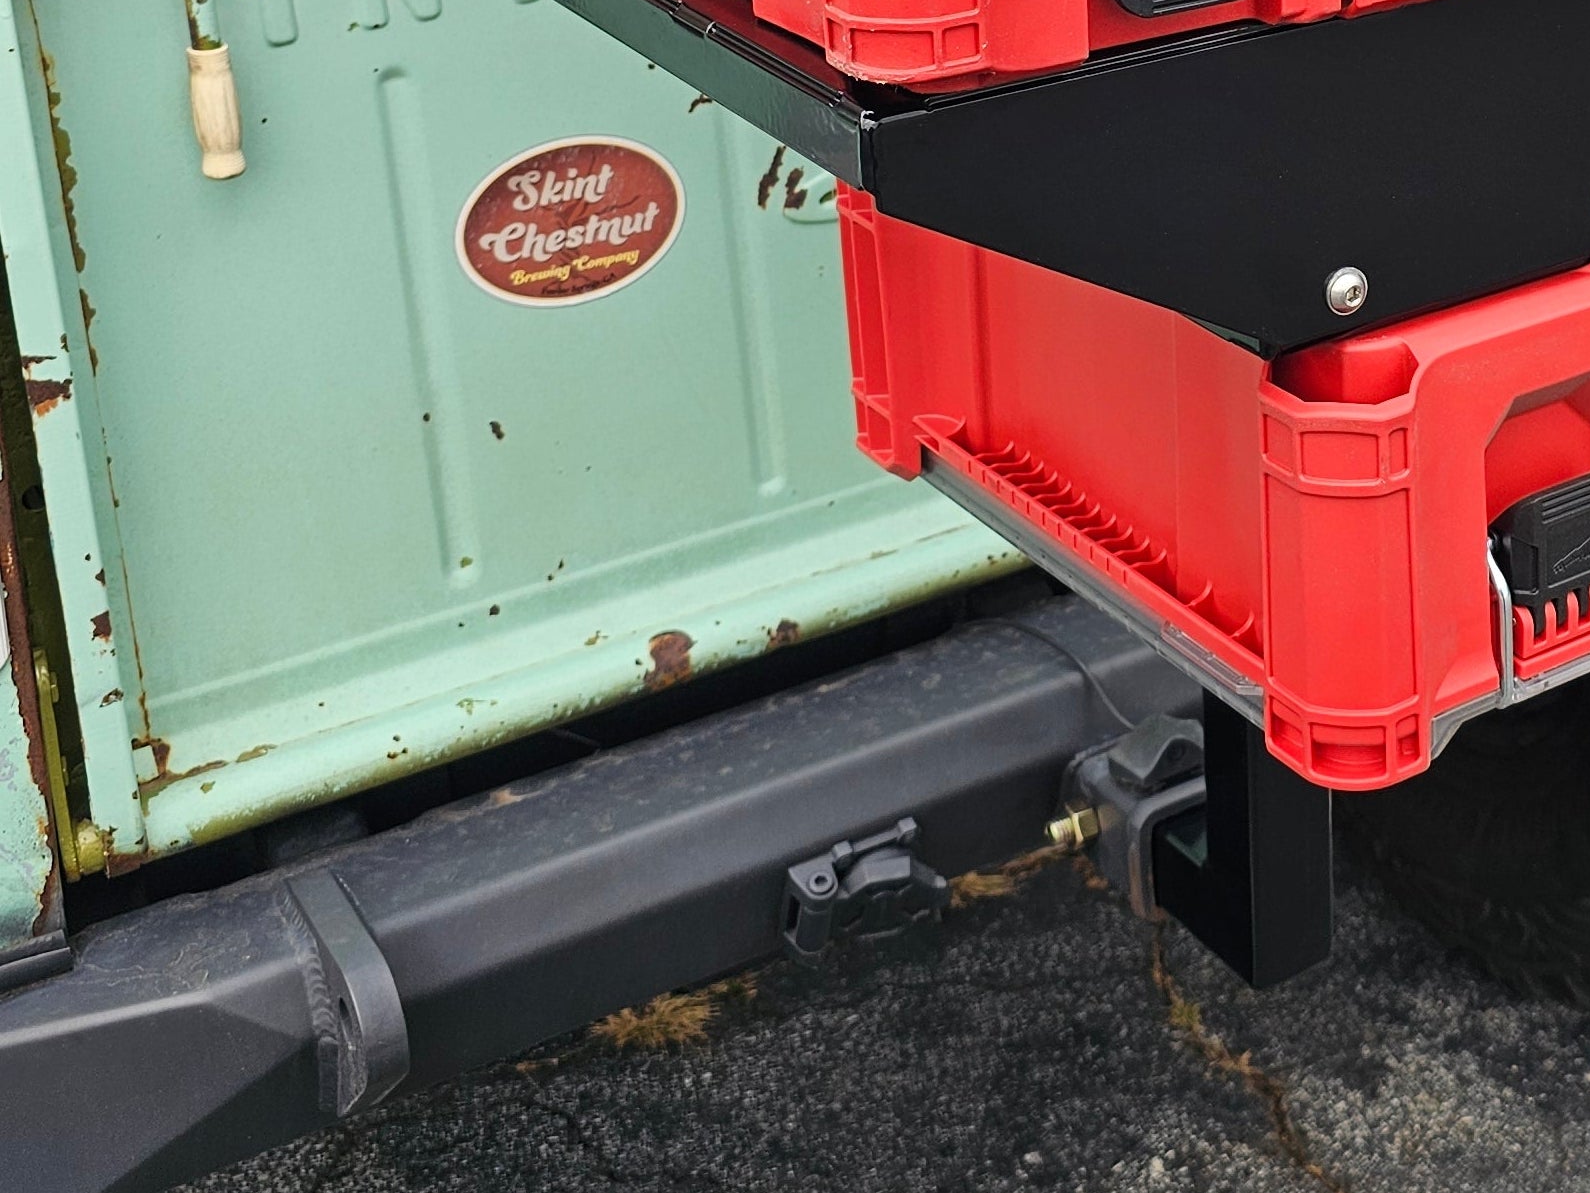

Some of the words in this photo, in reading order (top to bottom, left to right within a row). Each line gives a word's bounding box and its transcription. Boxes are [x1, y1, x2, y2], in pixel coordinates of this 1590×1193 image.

[507, 163, 614, 212] Skint
[478, 201, 660, 263] Chestnut
[510, 264, 571, 286] Brewing
[571, 249, 640, 272] Company
